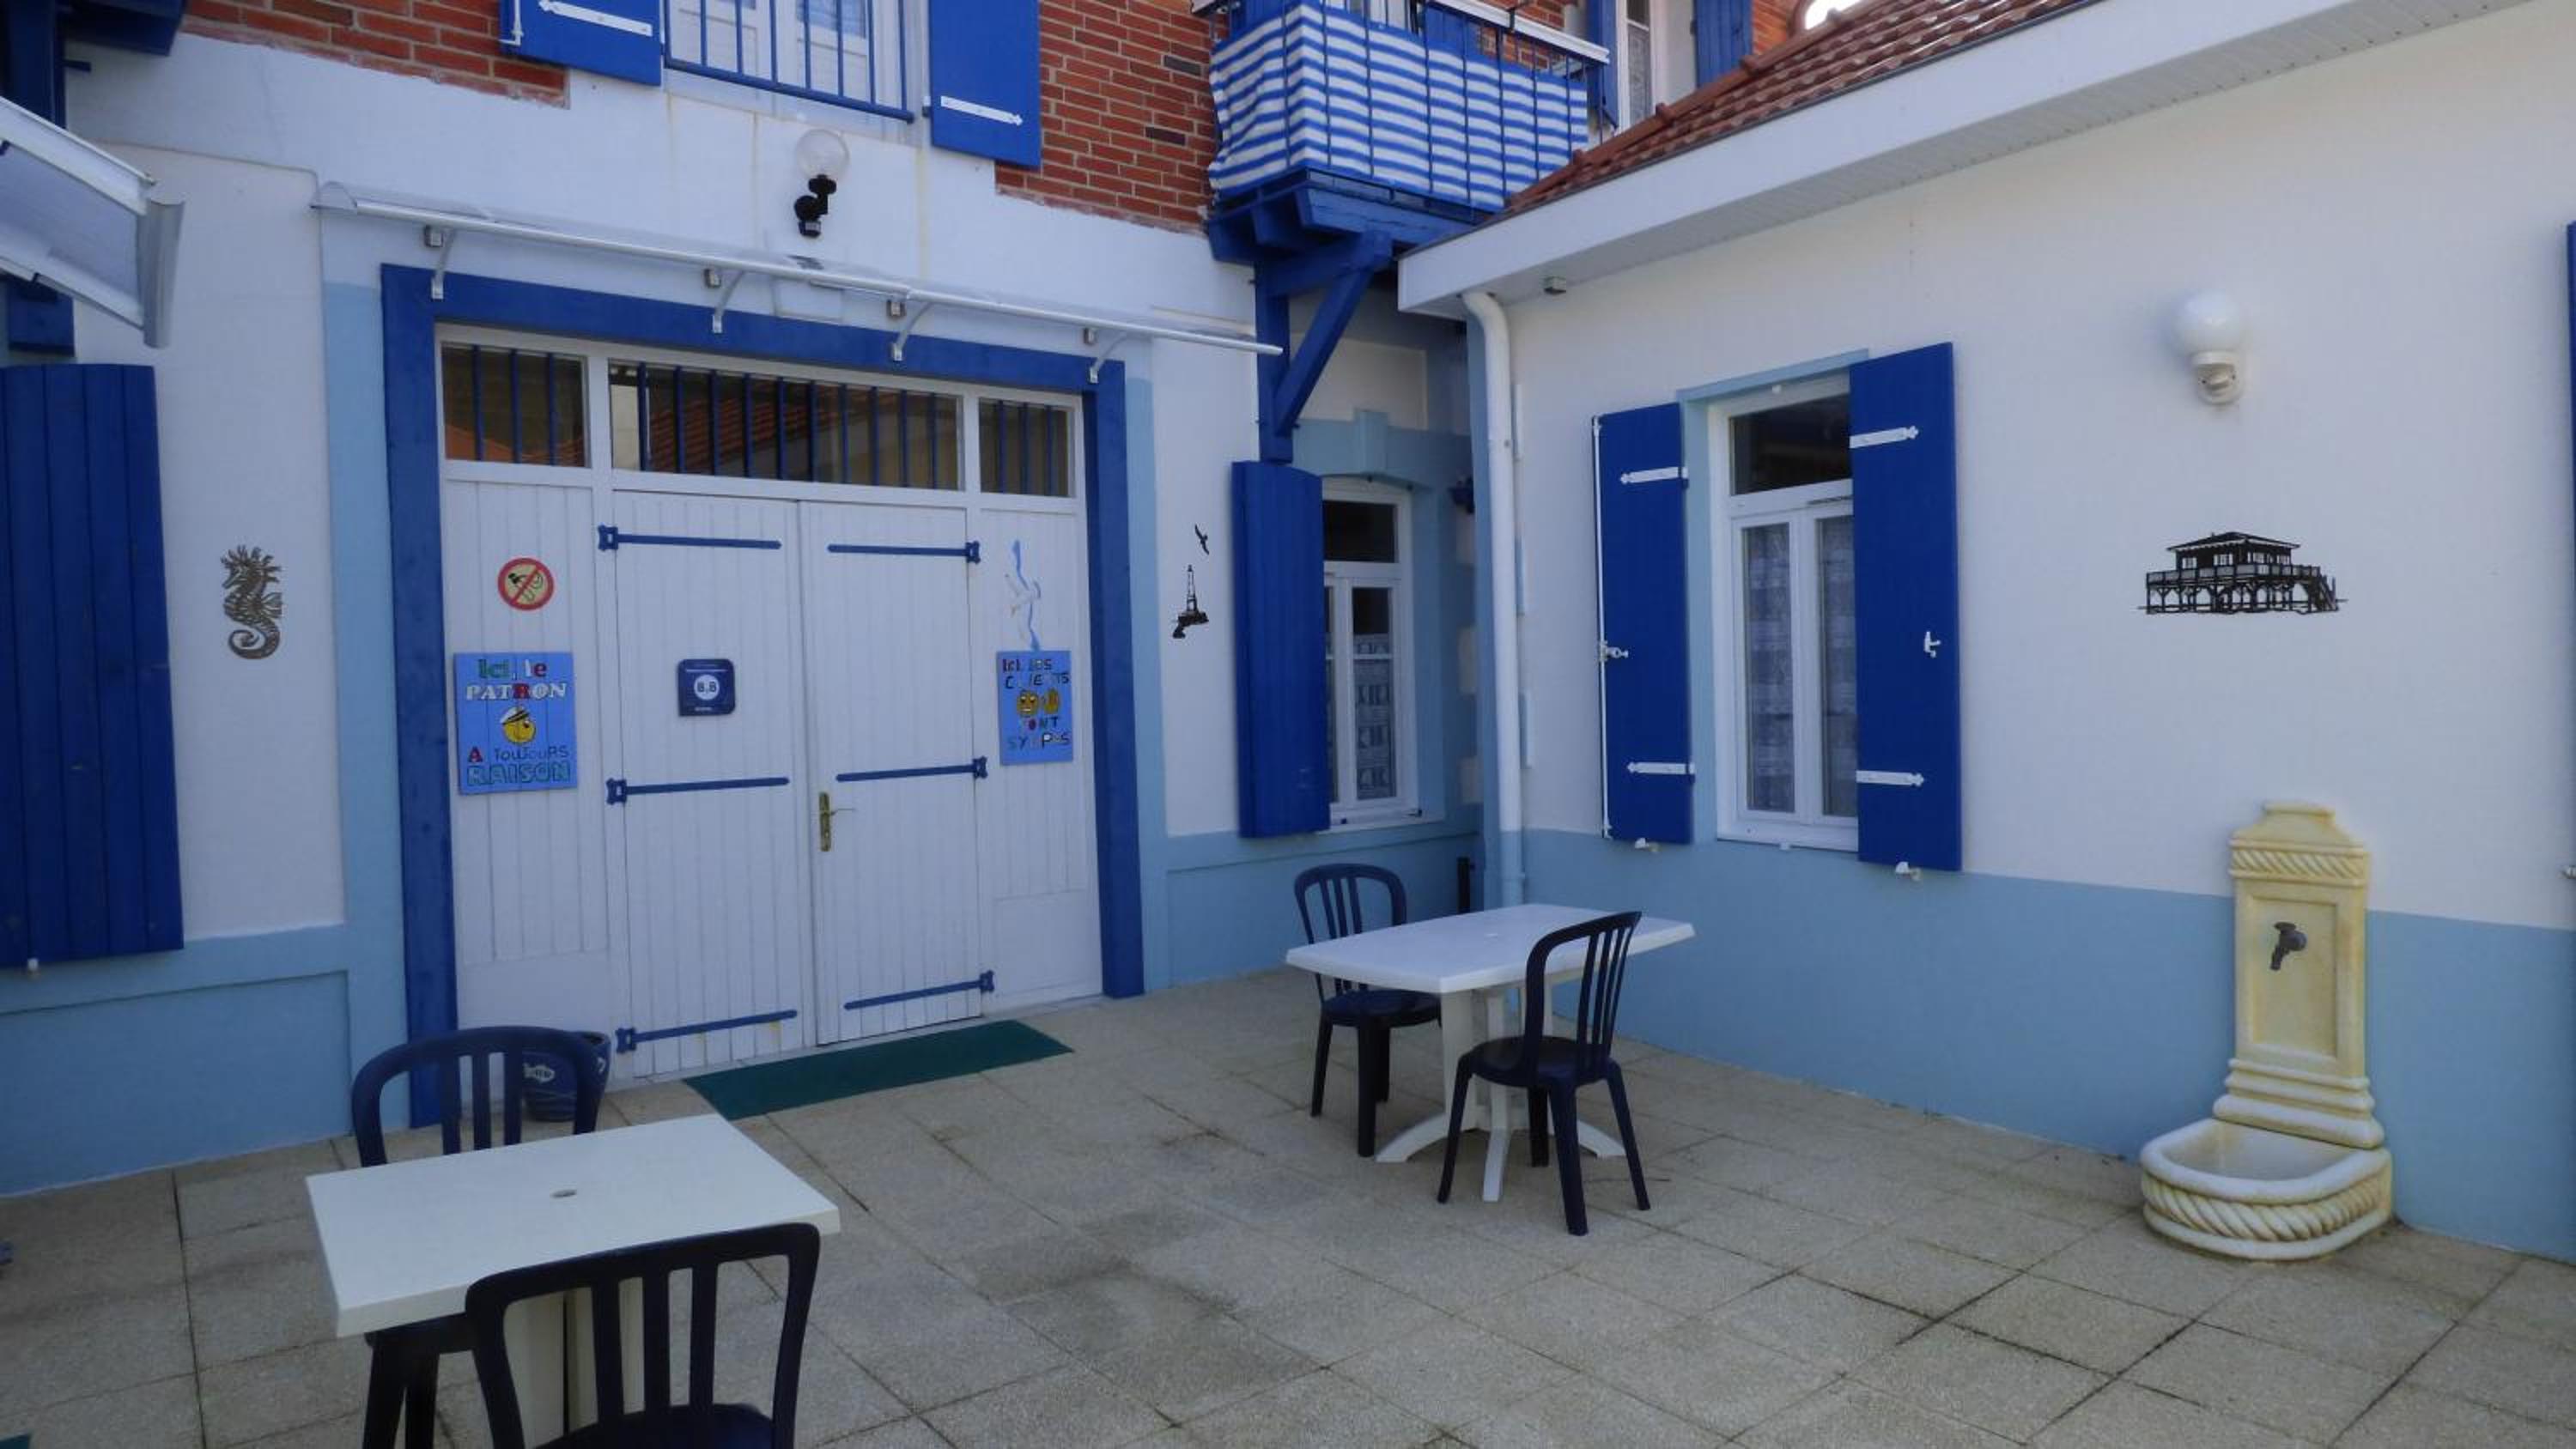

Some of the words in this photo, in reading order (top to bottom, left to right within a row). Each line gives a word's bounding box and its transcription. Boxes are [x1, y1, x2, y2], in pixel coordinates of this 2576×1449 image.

[525, 659, 548, 677] le
[1005, 672, 1070, 688] CIETS
[466, 682, 568, 700] PATRON
[468, 746, 483, 762] A
